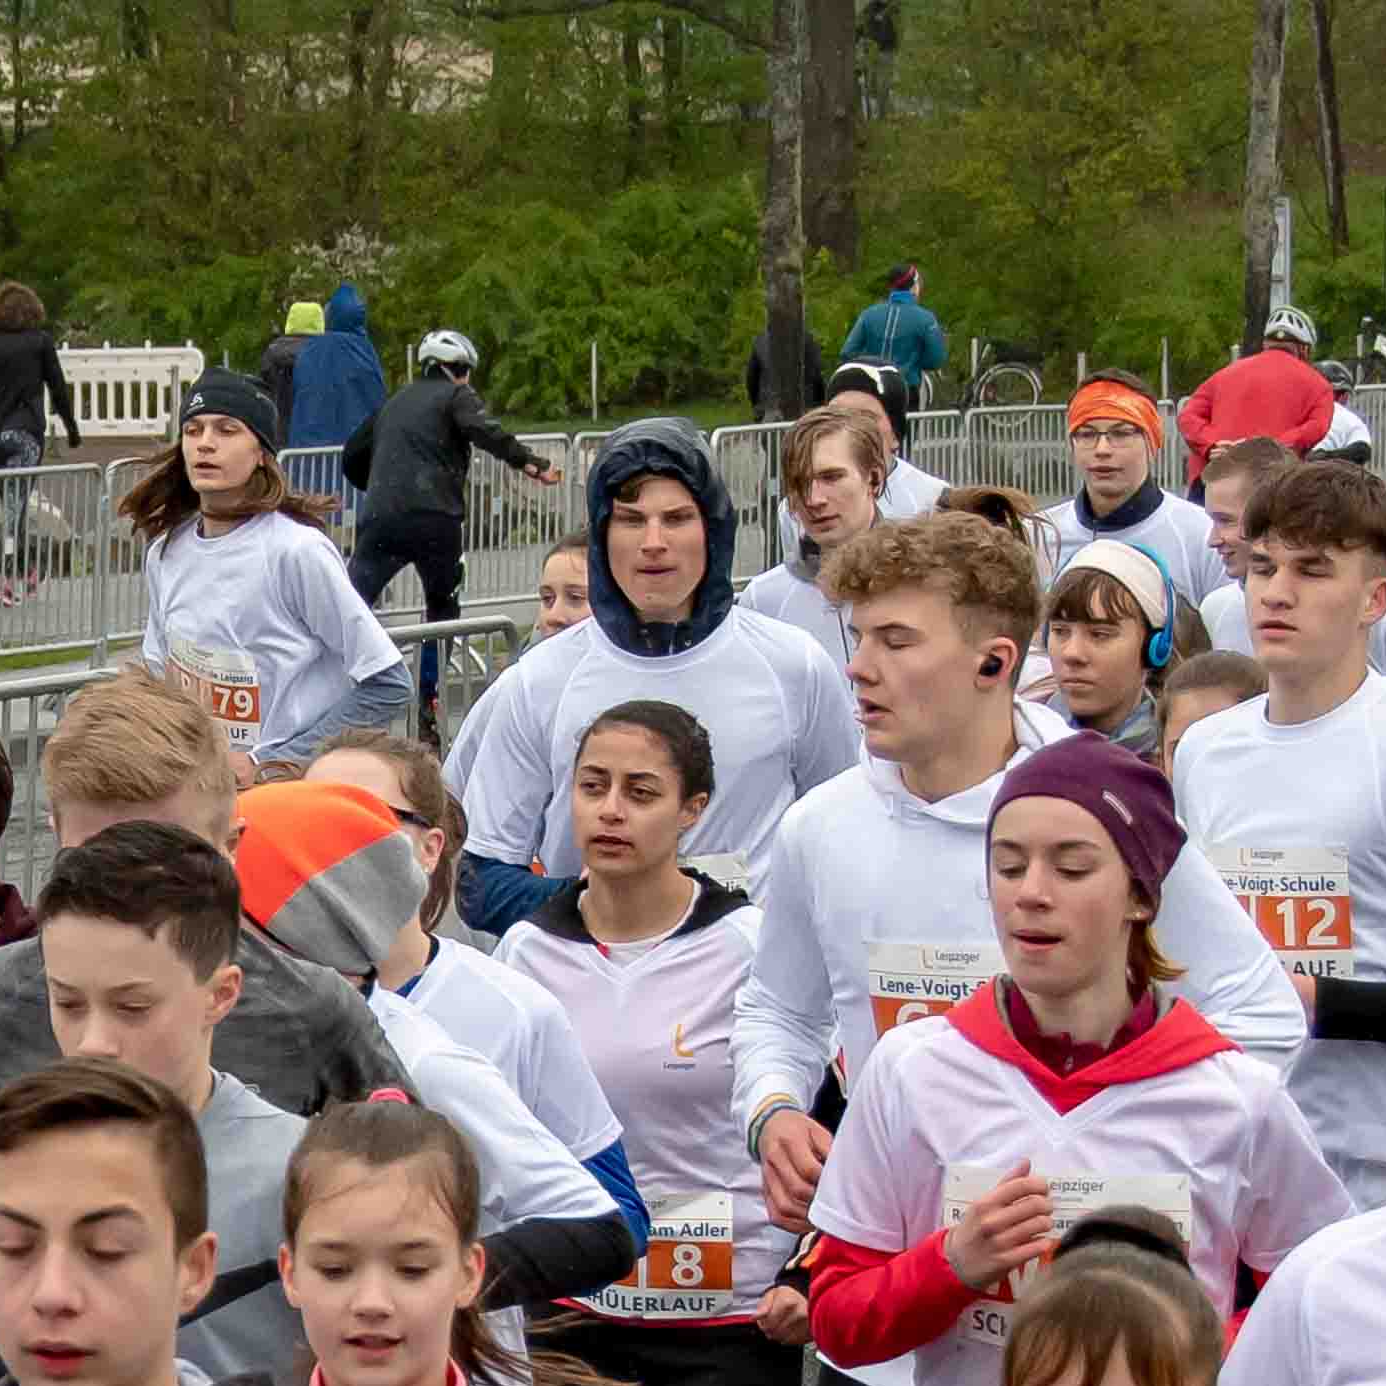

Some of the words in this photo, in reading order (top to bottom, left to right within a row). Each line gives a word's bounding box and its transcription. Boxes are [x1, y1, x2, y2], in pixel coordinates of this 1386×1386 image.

[213, 686, 254, 719] 79
[1276, 898, 1338, 946] 12
[679, 1223, 728, 1238] Adler
[671, 1243, 704, 1287] 8
